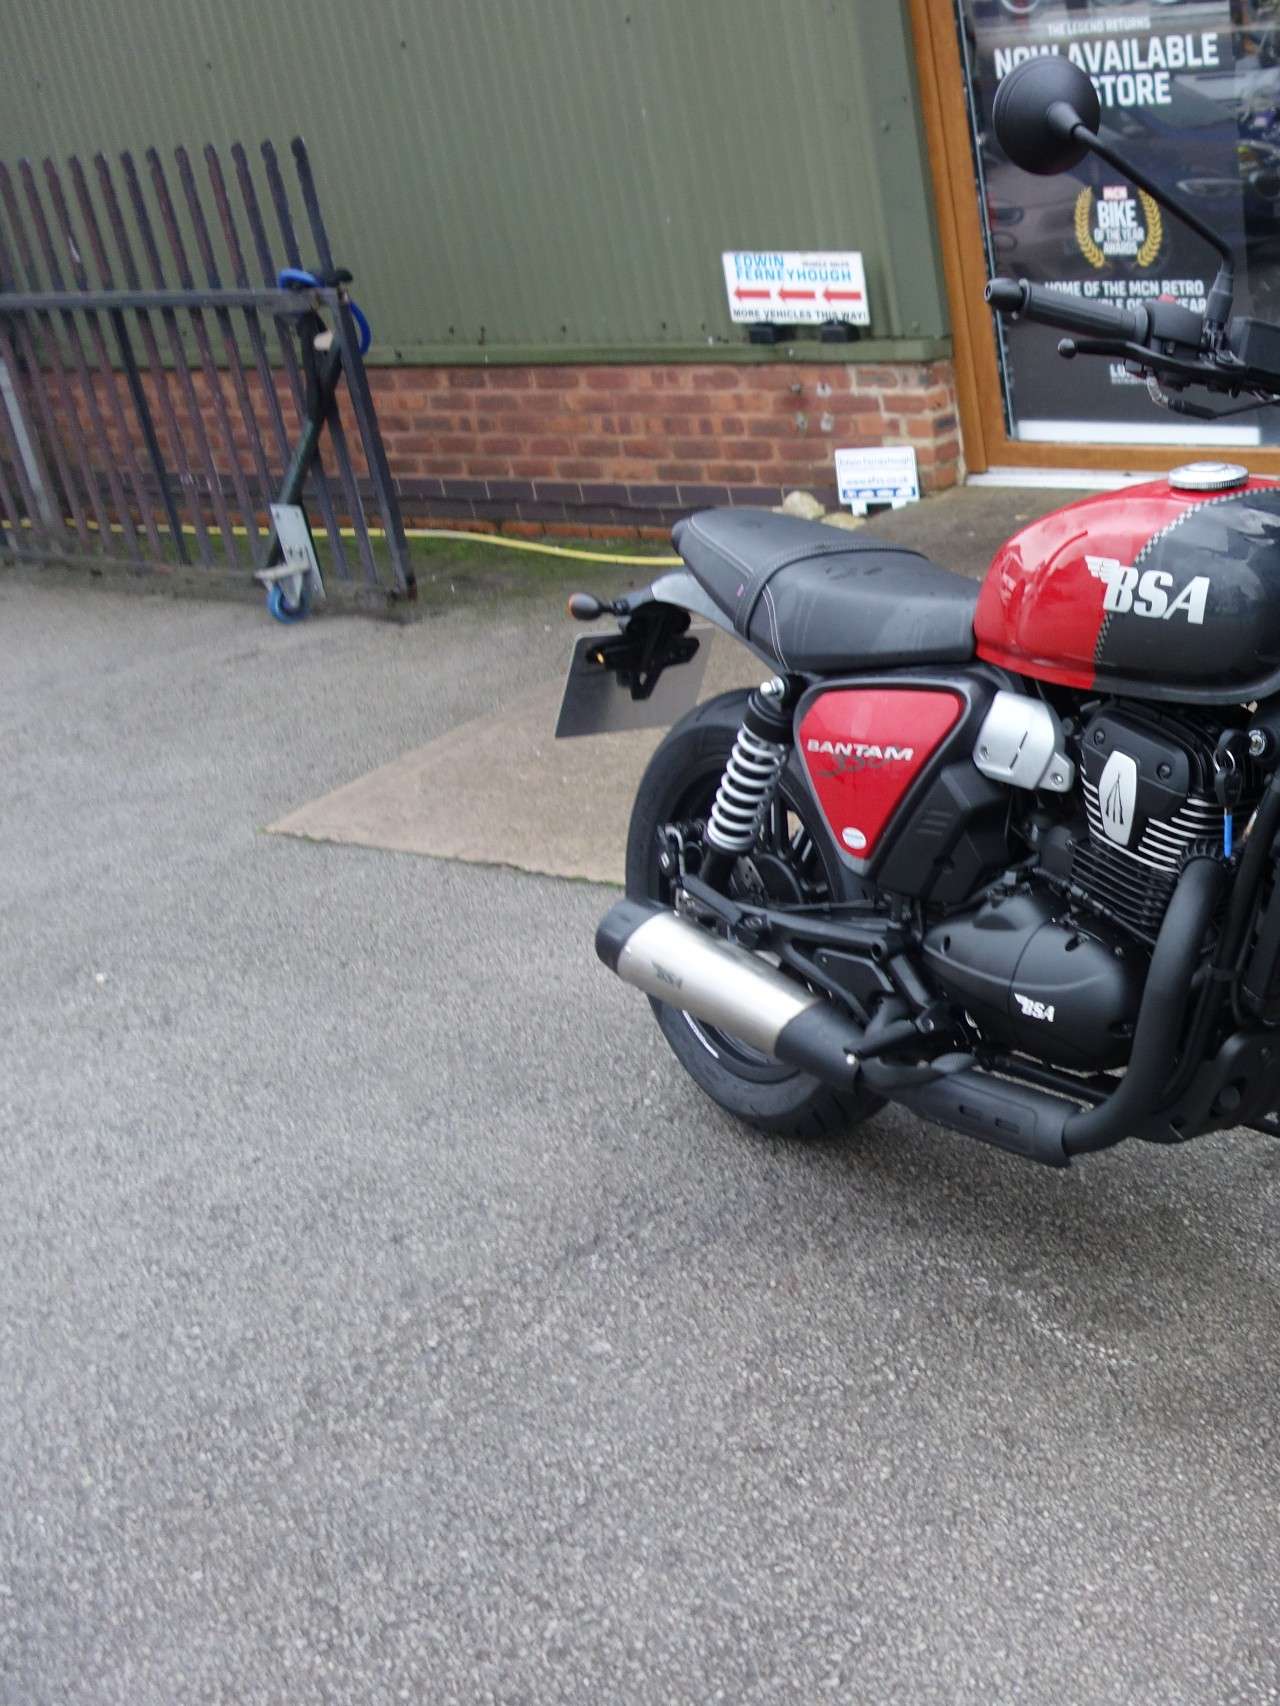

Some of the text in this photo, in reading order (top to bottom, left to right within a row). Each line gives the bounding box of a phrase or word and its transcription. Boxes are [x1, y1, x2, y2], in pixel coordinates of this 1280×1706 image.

[1067, 19, 1104, 34] LEGEND
[1105, 16, 1151, 32] RETURNS
[1068, 32, 1219, 73] AVAILABLE
[1097, 199, 1138, 229] BIKE
[1121, 227, 1145, 242] YEAR
[1103, 241, 1138, 255] AWARDS
[734, 254, 784, 267] EDWIN
[736, 268, 852, 282] FERNEYHOUGH
[1083, 281, 1100, 296] OF
[1102, 280, 1127, 296] THE
[1128, 280, 1160, 296] MCN
[1161, 280, 1205, 296] RETRO
[733, 309, 760, 318] MORE
[763, 310, 812, 320] VEHICLES
[815, 311, 837, 320] THIS
[1099, 562, 1210, 625] BSA
[807, 739, 914, 761] BANTAM
[1018, 996, 1055, 1022] BSA
